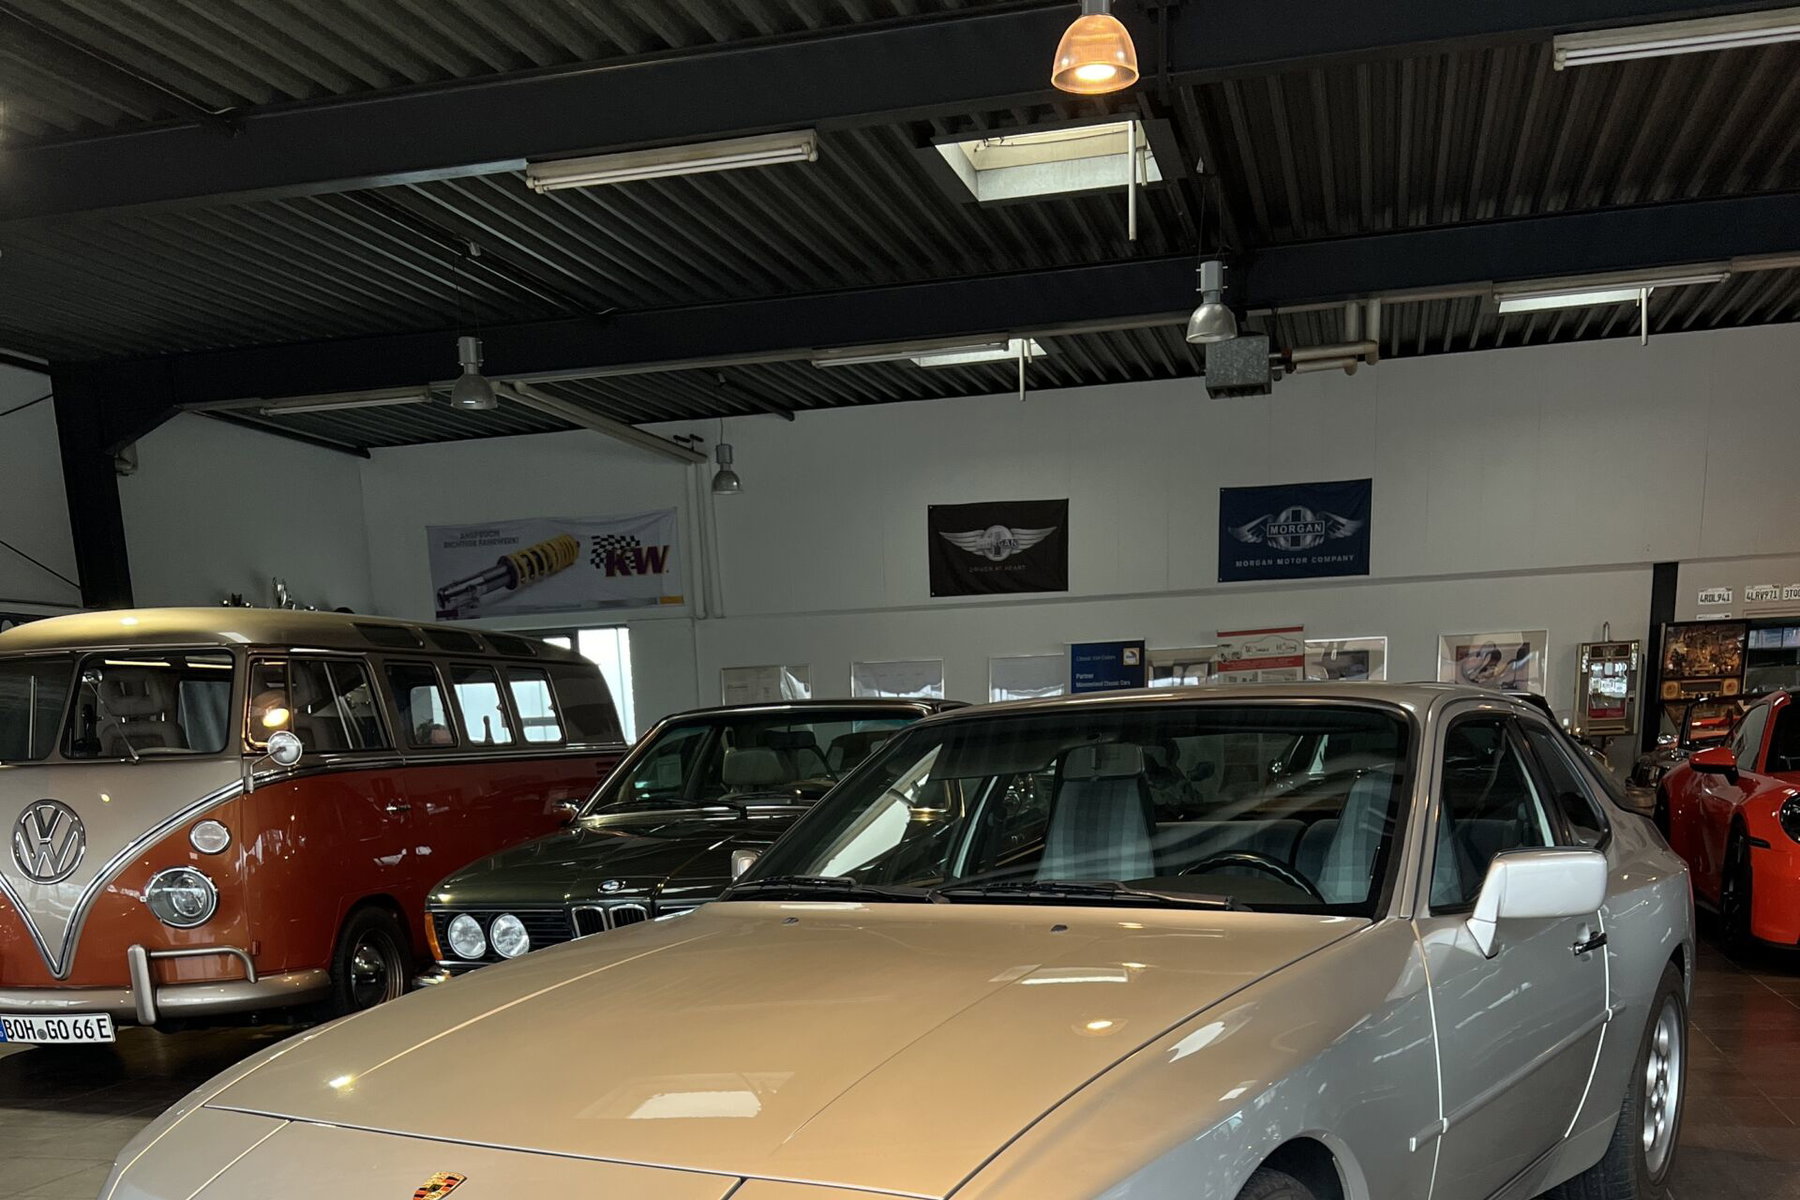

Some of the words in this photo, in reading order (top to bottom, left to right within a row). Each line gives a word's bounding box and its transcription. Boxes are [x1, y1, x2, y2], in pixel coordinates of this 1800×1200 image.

[1270, 523, 1321, 535] MORGAN
[605, 545, 669, 577] KW
[1236, 559, 1273, 567] MORGAN
[1277, 557, 1307, 565] MOTOR
[1312, 555, 1354, 564] COMPANY
[2, 1019, 37, 1040] BOH
[45, 1019, 70, 1040] GO
